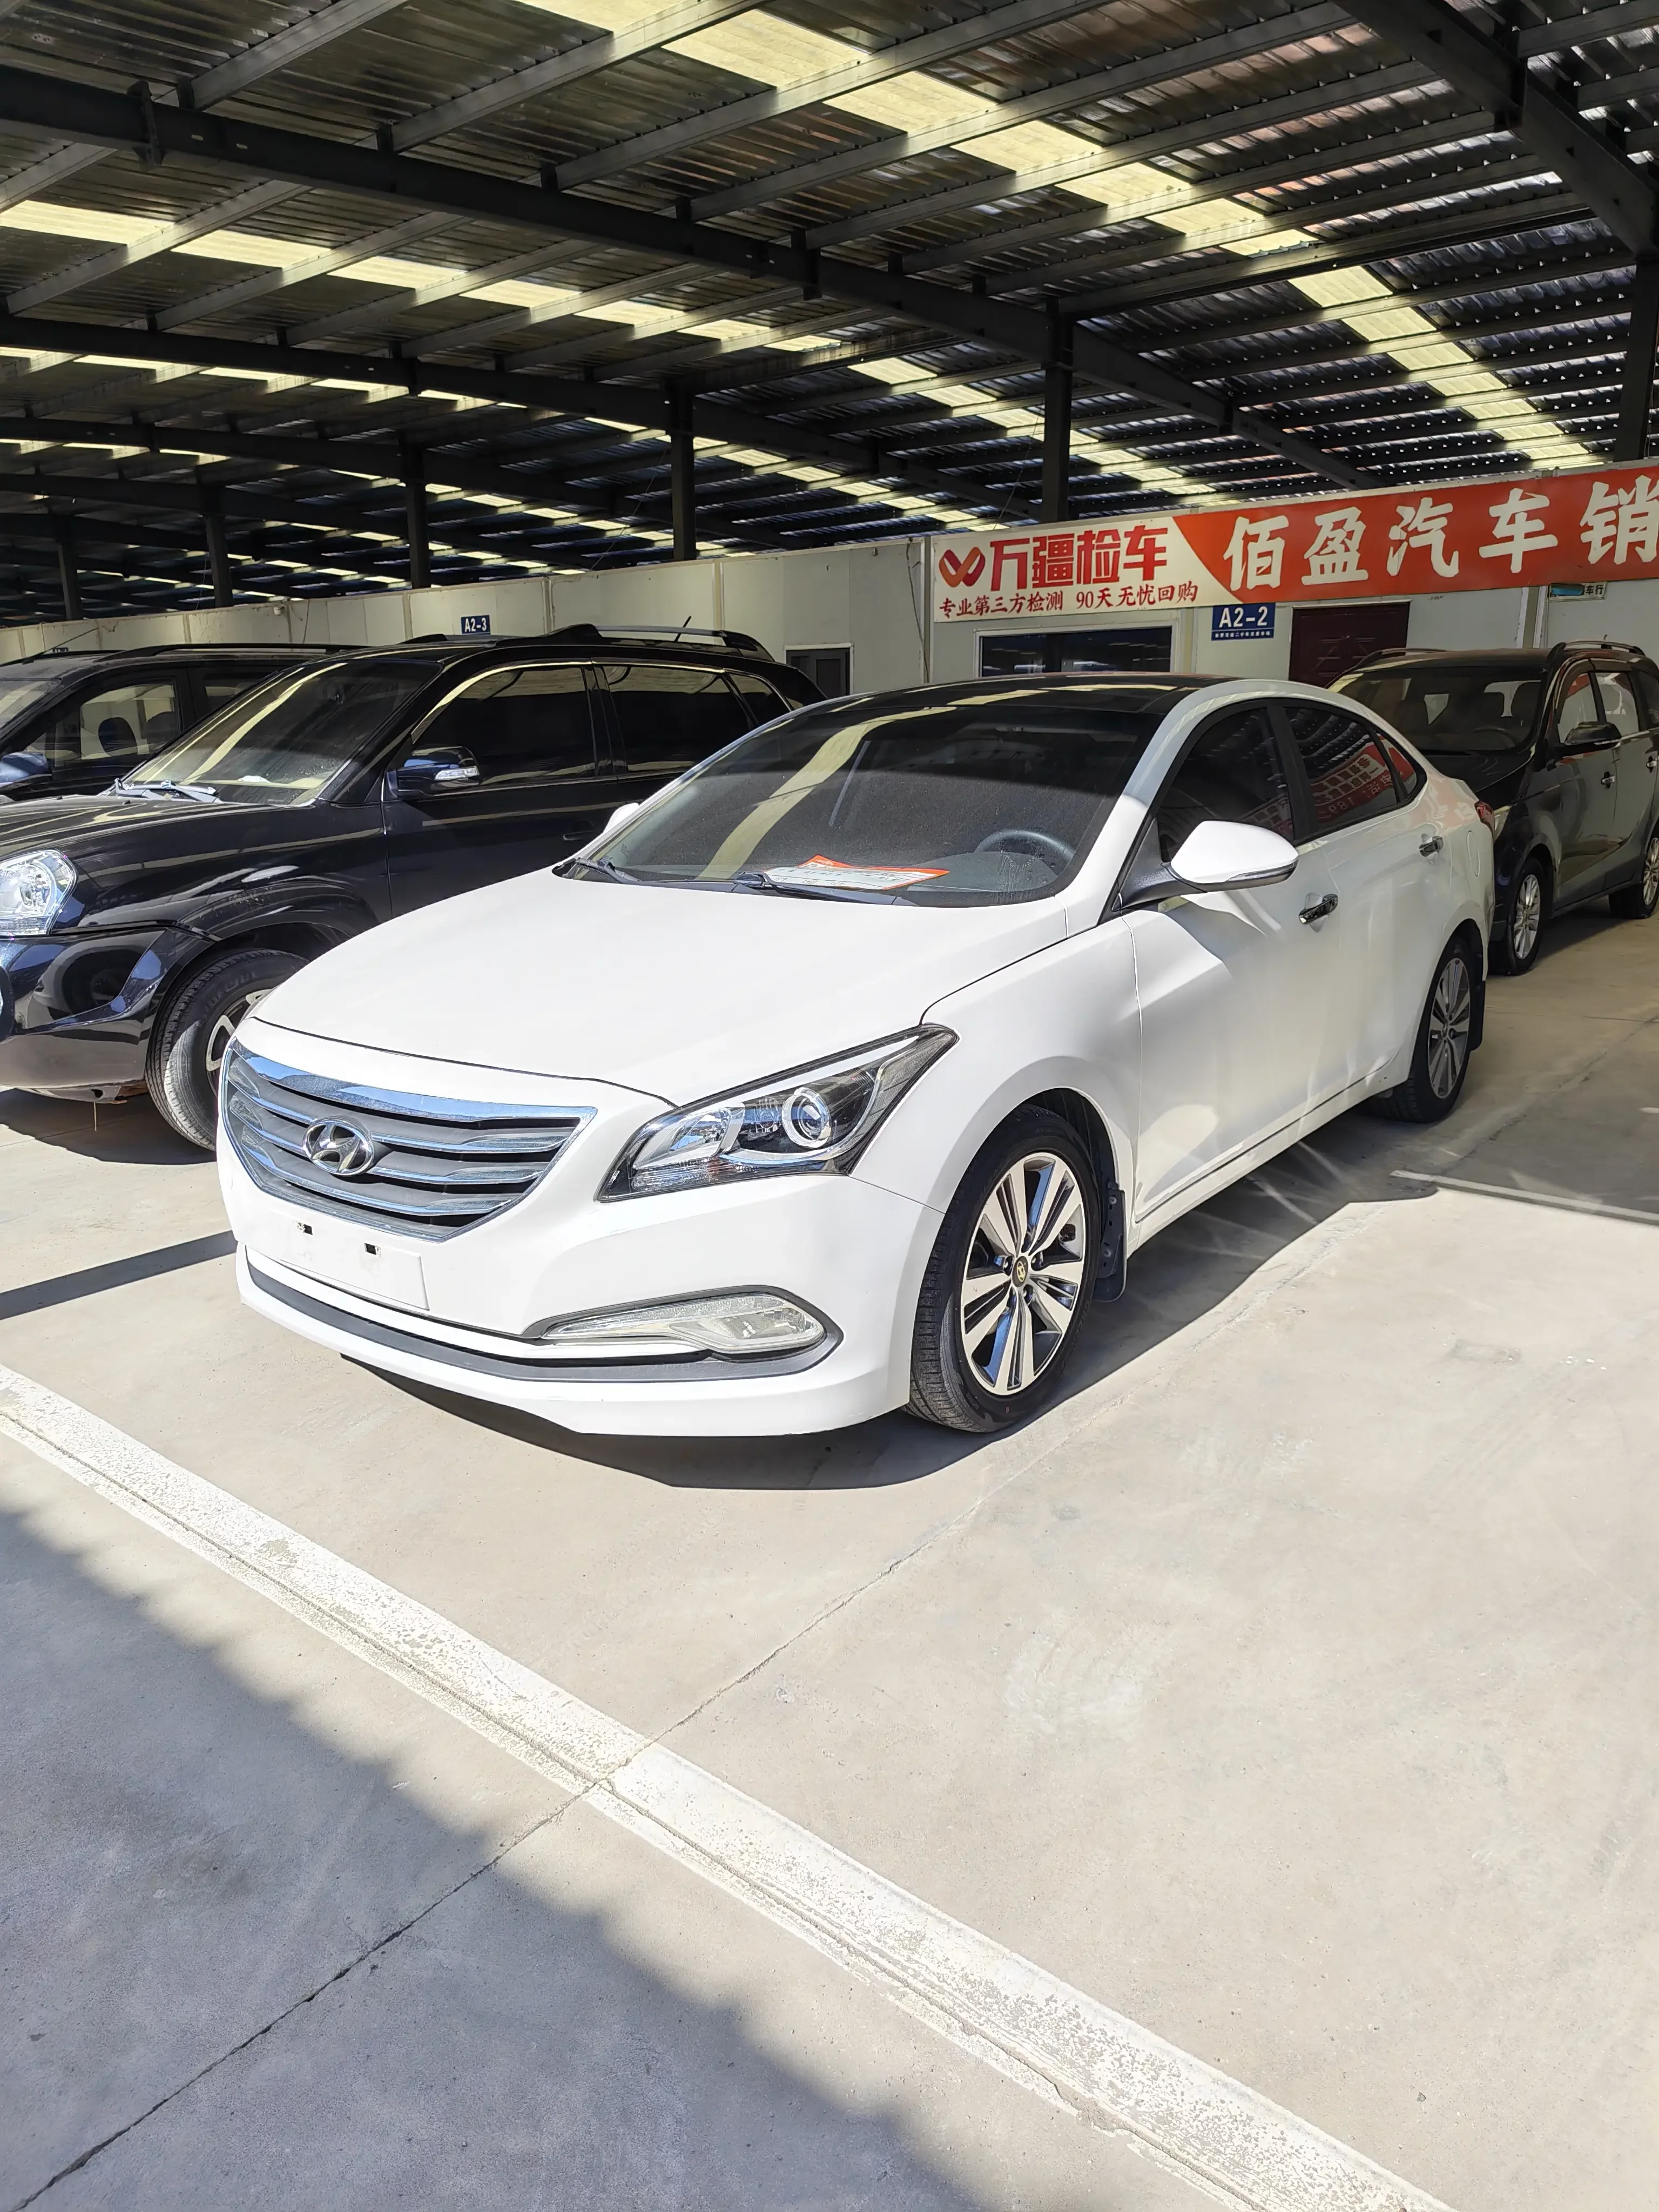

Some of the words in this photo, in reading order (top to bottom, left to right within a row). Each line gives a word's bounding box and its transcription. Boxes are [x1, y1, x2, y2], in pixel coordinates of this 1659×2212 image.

[1223, 475, 1659, 591] 佰盈汽车销
[989, 524, 1168, 592] 万疆检车
[939, 590, 1063, 618] 专业第三方检测
[1076, 580, 1199, 609] 90天无忧回购
[1218, 605, 1268, 628] A2-2
[464, 617, 487, 632] A2-3
